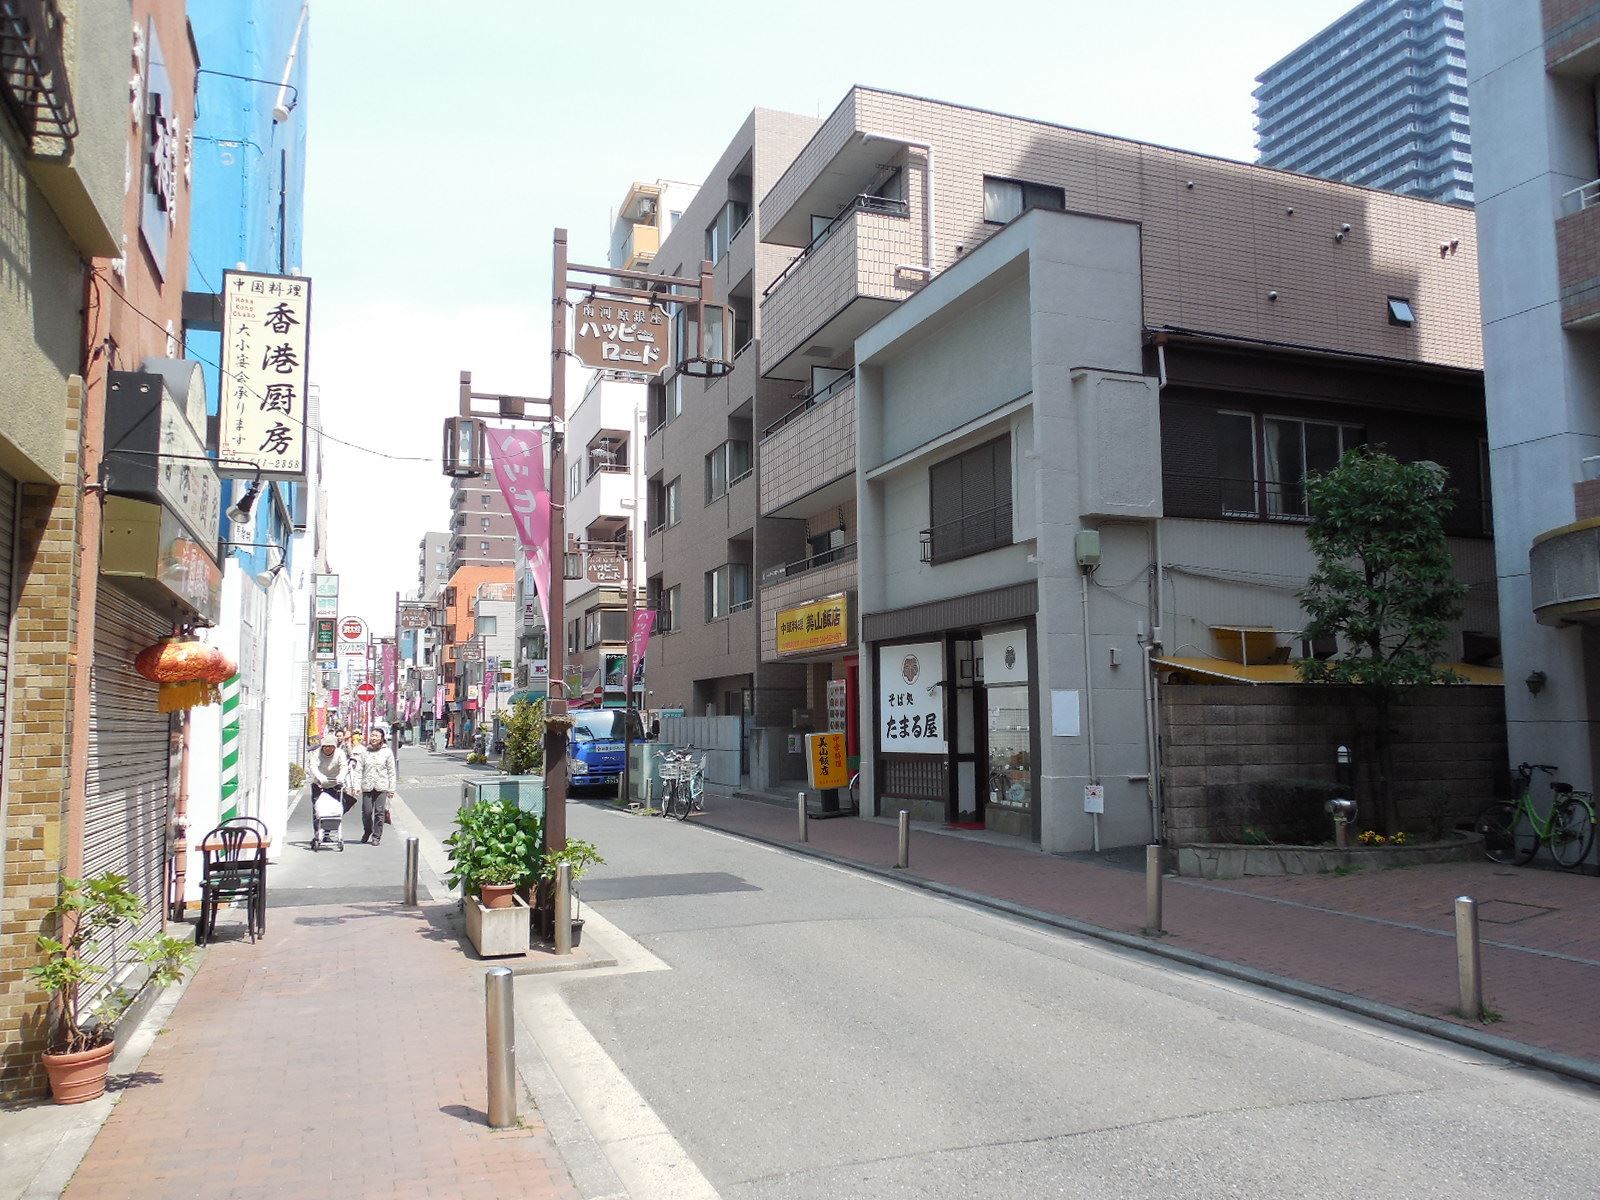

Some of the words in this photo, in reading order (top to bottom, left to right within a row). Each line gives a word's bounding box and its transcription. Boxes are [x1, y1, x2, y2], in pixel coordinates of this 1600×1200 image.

[233, 278, 302, 297] 中国料理
[582, 304, 662, 325] 南河原銀座
[579, 321, 655, 344] ハッピー
[602, 340, 660, 366] ロード
[231, 323, 251, 446] 大小宴会承ります
[259, 302, 301, 455] 香港厨房
[588, 563, 620, 572] ハッピー
[597, 572, 621, 581] ロード
[806, 606, 841, 633] 美山飯店
[888, 691, 914, 707] そば処
[886, 712, 938, 739] たまる屋
[817, 737, 830, 776] 美山飯店
